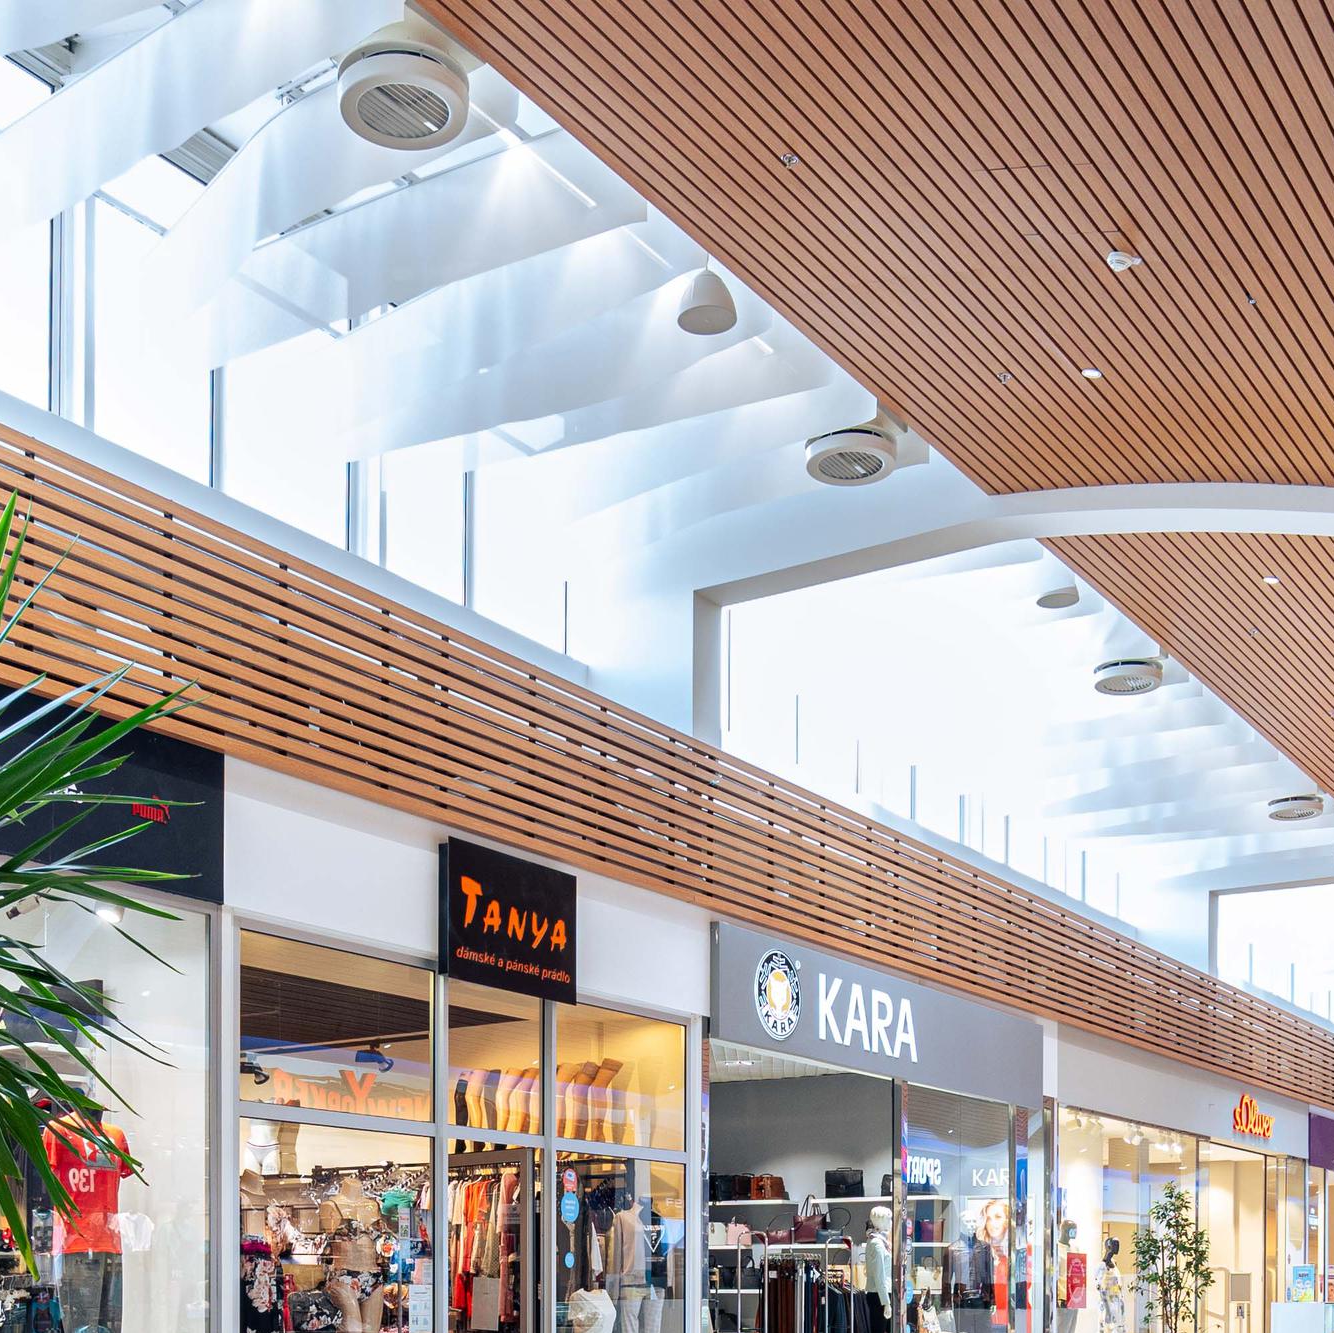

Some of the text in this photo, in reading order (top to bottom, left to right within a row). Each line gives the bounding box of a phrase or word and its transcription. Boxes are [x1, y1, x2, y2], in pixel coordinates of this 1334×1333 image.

[132, 802, 167, 825] PUMA
[460, 875, 567, 952] TANYA
[455, 945, 571, 985] dámské a pánské prádlo
[763, 1012, 795, 1034] KARA
[818, 972, 918, 1064] KARA
[1234, 1094, 1275, 1138] s.Oliver
[973, 1168, 1009, 1187] KAR
